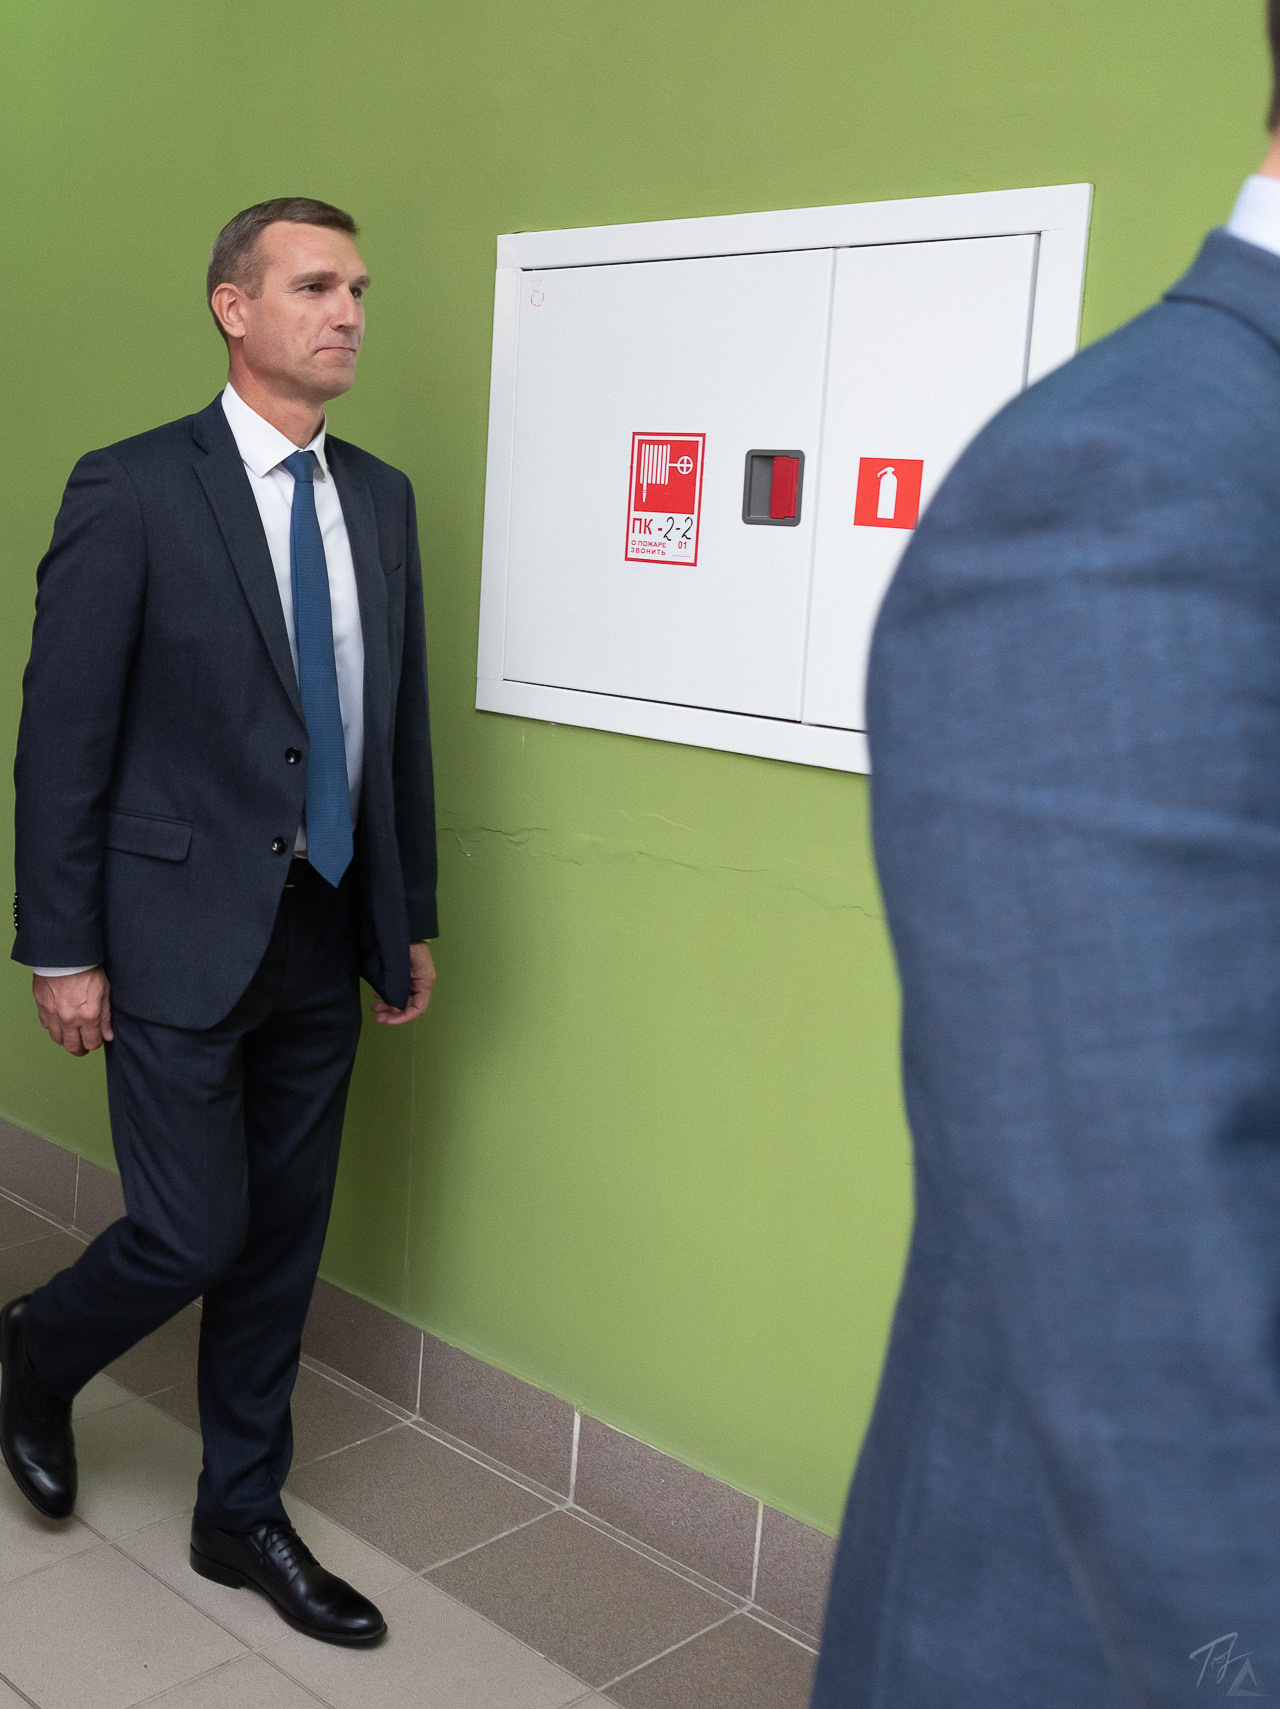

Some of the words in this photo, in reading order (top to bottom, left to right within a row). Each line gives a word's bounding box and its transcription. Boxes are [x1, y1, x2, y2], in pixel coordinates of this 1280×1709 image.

[632, 517, 654, 535] ПК
[638, 540, 667, 548] ПОЖАРЕ
[677, 541, 687, 549] 01
[631, 547, 666, 555] ЗВОНИТЬ
